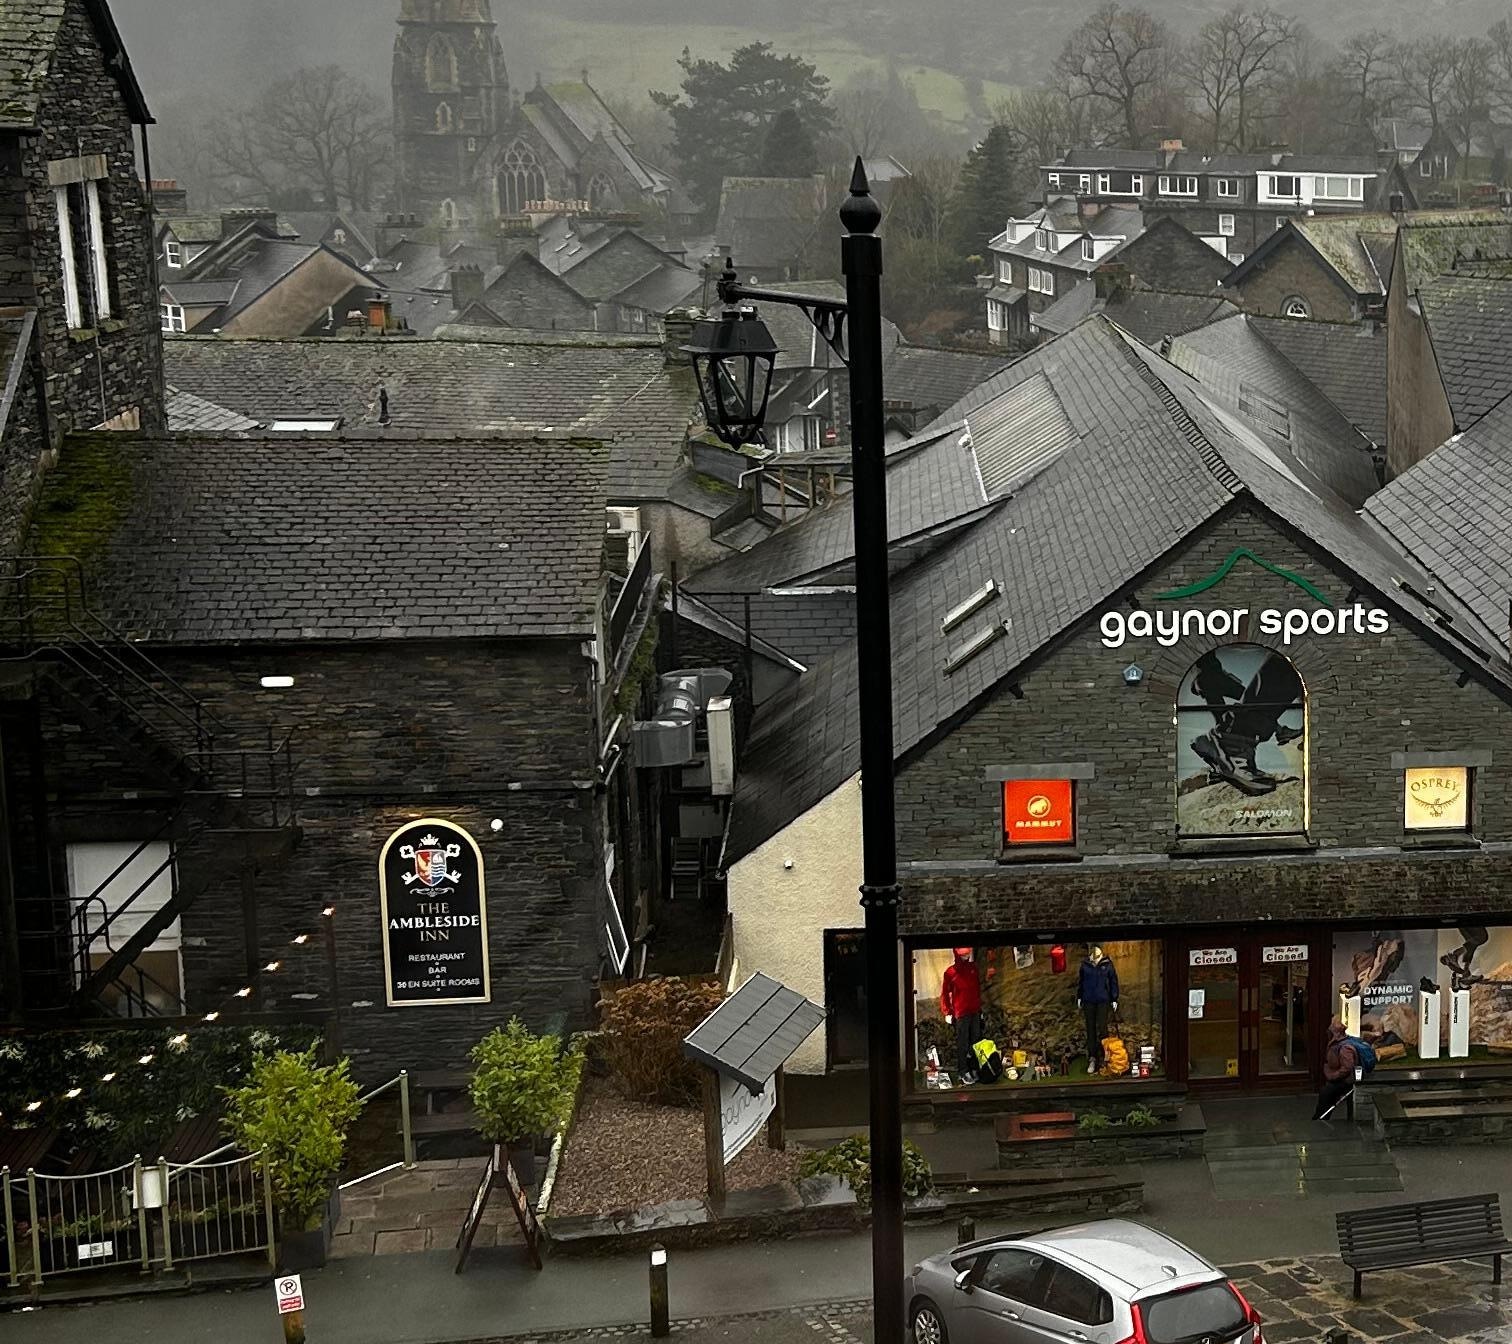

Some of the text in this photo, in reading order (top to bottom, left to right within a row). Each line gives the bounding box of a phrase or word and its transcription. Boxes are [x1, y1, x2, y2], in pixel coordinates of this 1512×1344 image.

[1100, 603, 1390, 648] gaynor sports
[1235, 809, 1292, 818] SALOMON
[417, 902, 450, 914] THE
[389, 915, 480, 930] AMBLESIDE
[420, 930, 449, 942] INN
[408, 952, 466, 962] RESTAURANT
[1195, 955, 1233, 965] Closed
[1266, 952, 1304, 962] Closed
[428, 966, 447, 974] BAR
[421, 978, 447, 987] SUITE
[1363, 984, 1413, 996] DYNAMIC
[1363, 995, 1413, 1006] SUPPORT
